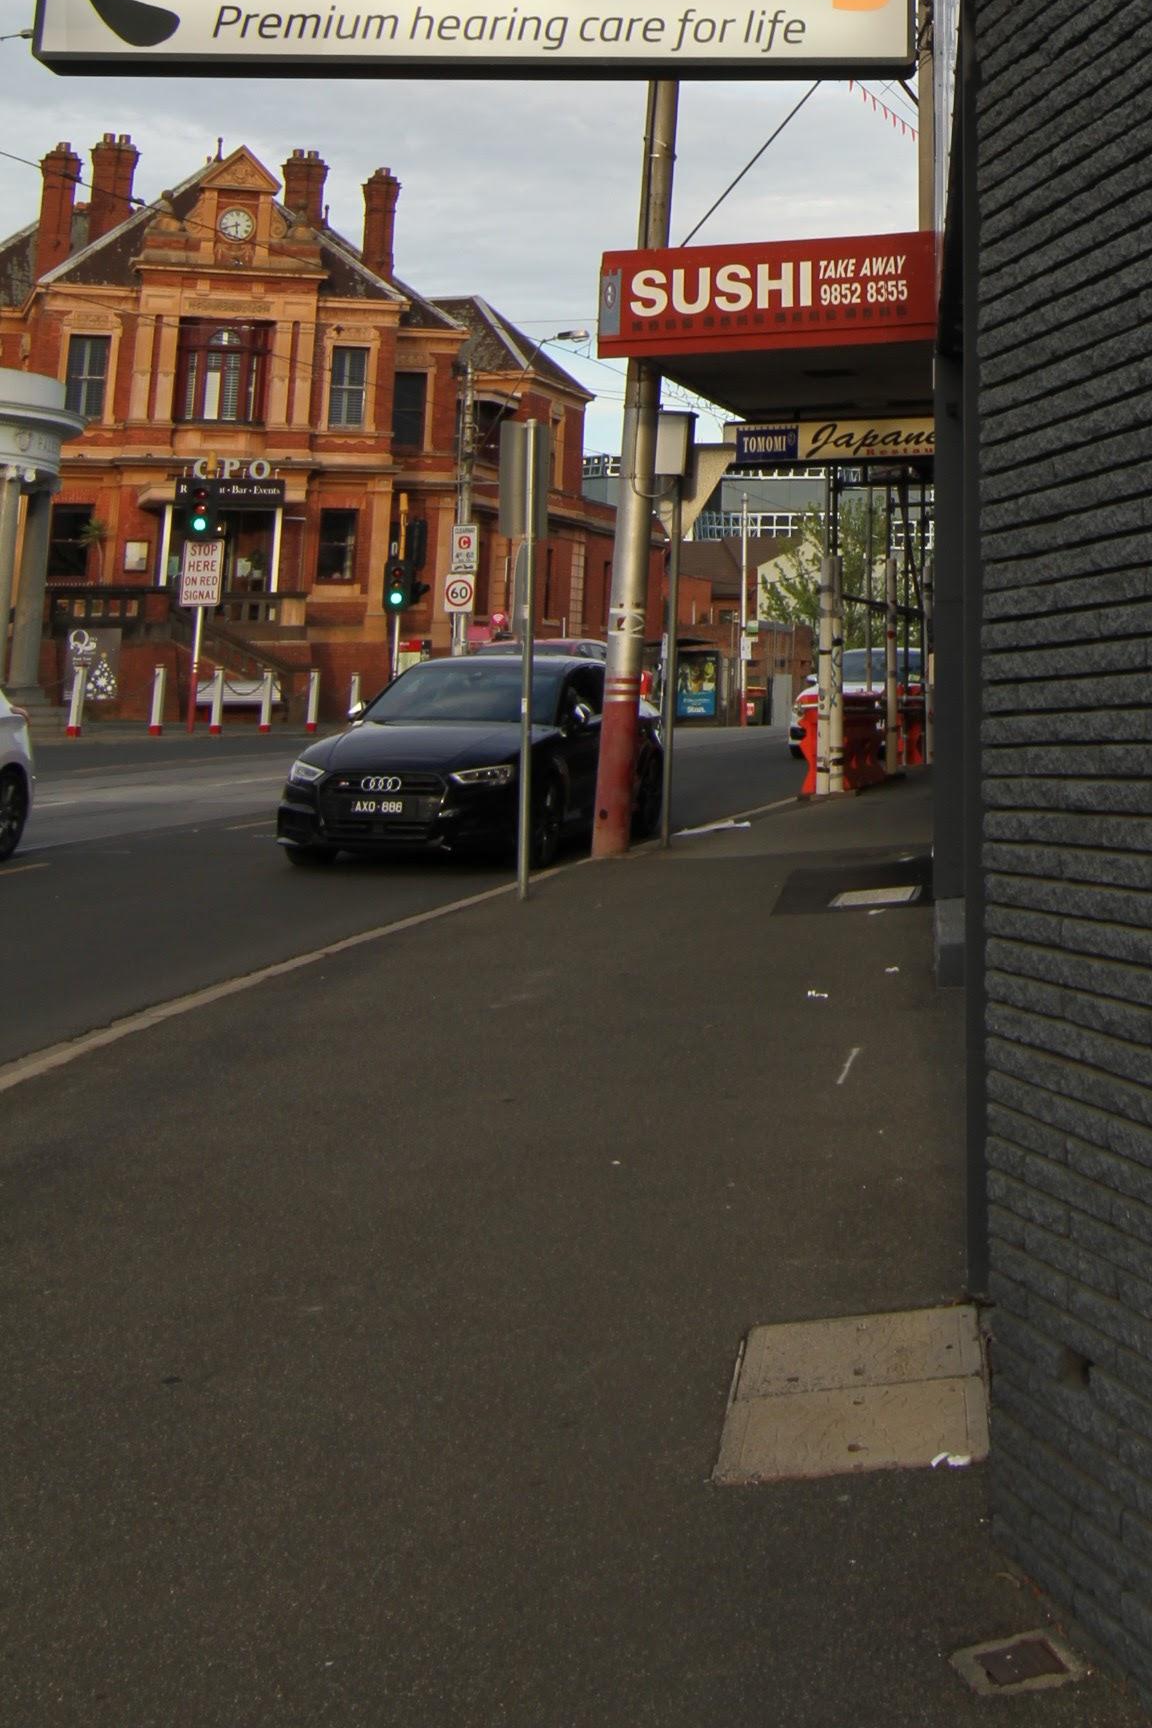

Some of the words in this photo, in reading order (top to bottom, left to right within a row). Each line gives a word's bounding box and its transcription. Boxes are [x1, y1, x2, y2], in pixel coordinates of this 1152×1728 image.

[211, 5, 399, 41] Premium
[409, 6, 569, 50] hearing
[579, 15, 665, 43] care
[671, 9, 736, 52] for
[744, 10, 806, 53] life
[818, 258, 856, 279] TAKE
[859, 255, 907, 278] AWAY
[629, 260, 812, 317] SUSHI
[820, 283, 861, 306] 9852
[866, 280, 908, 303] 8355
[743, 434, 787, 453] TOMOMI
[231, 484, 248, 494] Bar
[253, 485, 281, 495] Events
[190, 544, 218, 556] STOP
[188, 560, 216, 573] HERE
[185, 576, 198, 586] ON
[200, 576, 218, 586] RED
[183, 590, 217, 601] SIGNAL
[450, 586, 468, 599] 60
